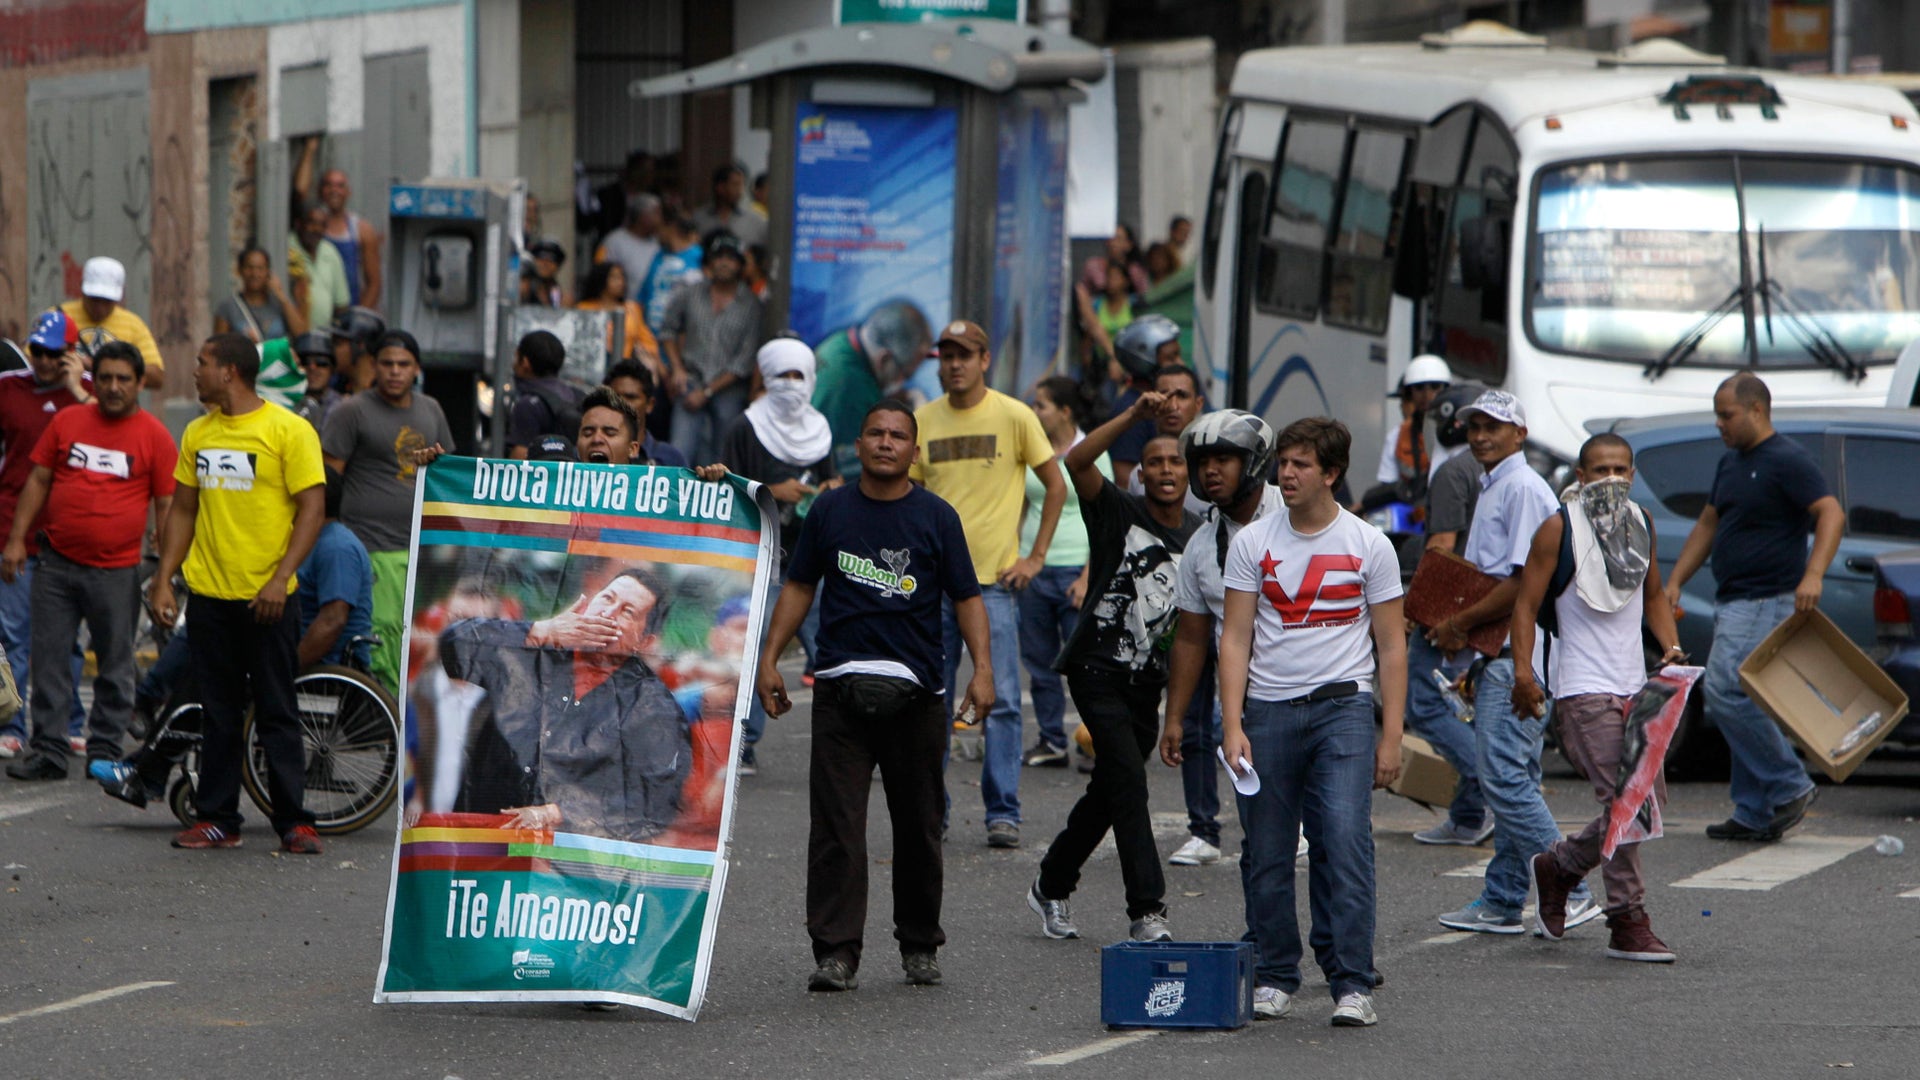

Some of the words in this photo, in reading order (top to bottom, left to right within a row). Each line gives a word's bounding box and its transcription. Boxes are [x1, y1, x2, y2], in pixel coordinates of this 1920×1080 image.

[473, 457, 549, 502] brota
[554, 462, 629, 510] lluvia
[635, 466, 670, 514] de
[678, 477, 735, 521] vida
[838, 550, 898, 588] Wilson
[446, 879, 489, 939] ¡Te
[494, 879, 645, 945] Amamos!
[1153, 994, 1180, 1009] ICE
